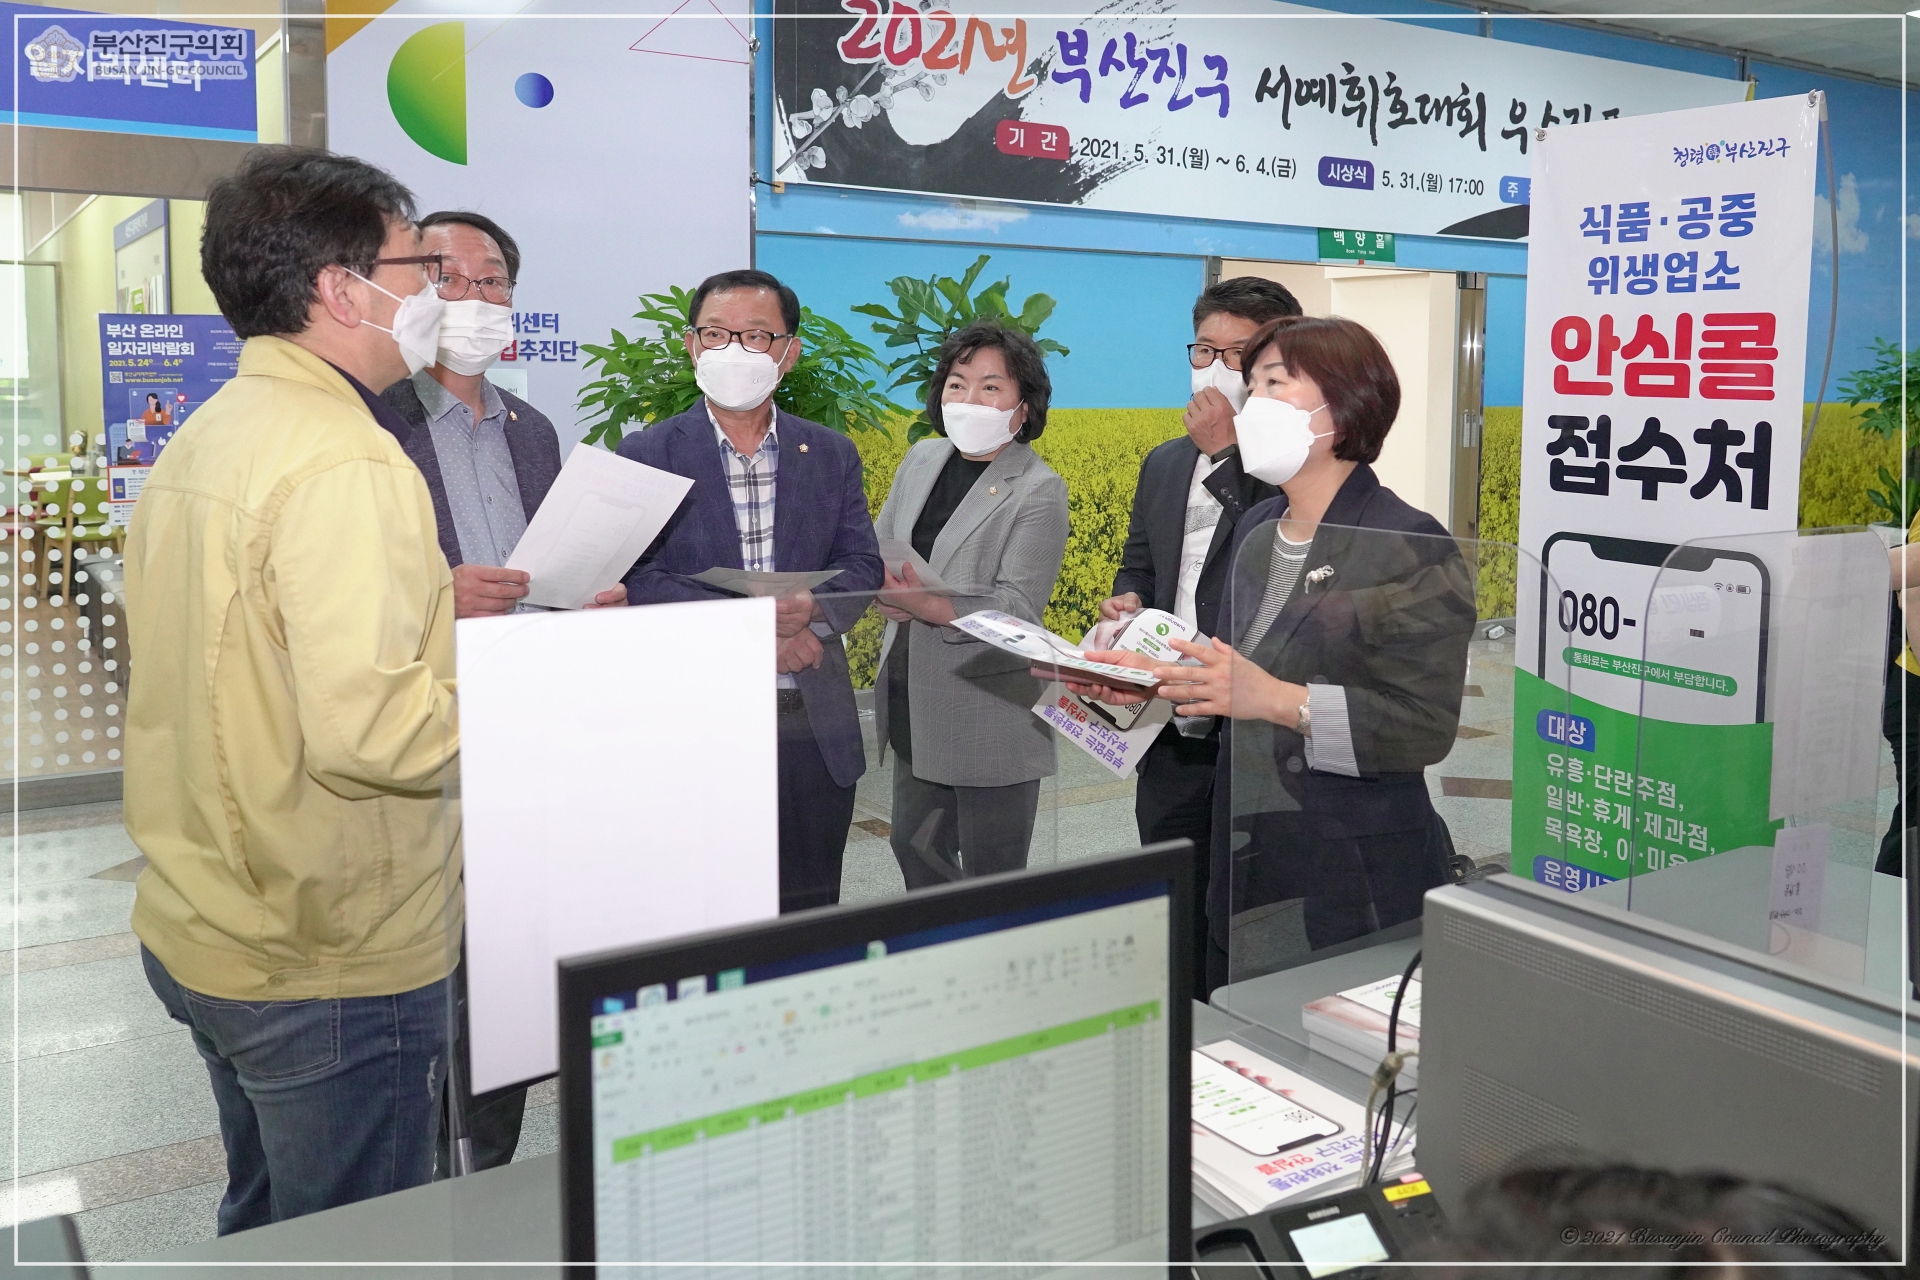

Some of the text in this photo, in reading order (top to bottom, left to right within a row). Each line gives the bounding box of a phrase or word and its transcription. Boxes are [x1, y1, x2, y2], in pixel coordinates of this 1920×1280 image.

[841, 0, 1035, 95] 2021년
[1052, 28, 1230, 118] 부산진구
[1255, 62, 1487, 151] 서예휘호대회
[1725, 137, 1791, 163] 부산진구
[1327, 163, 1367, 183] 시상식
[1400, 172, 1443, 194] 31.(월)
[1448, 178, 1484, 196] 17:00
[1587, 250, 1742, 296] 위생업소
[106, 323, 184, 338] 부산 온라인
[107, 341, 195, 356] 일자리박람회
[1550, 312, 1779, 401] 안심콜
[124, 376, 184, 384] www.busanjob.net
[1546, 414, 1773, 511] 접수처
[1558, 589, 1636, 641] 080-
[1573, 651, 1729, 693] 통화료는 부산진구에서 부담합니다.
[1043, 704, 1125, 770] 부담없는 전화한통
[1057, 695, 1129, 754] 부산진구 안심콜
[1547, 715, 1587, 745] 대상
[1545, 816, 1608, 858] 목욕장,
[1543, 860, 1620, 892] 운영시
[1255, 1153, 1314, 1177] 안심콜
